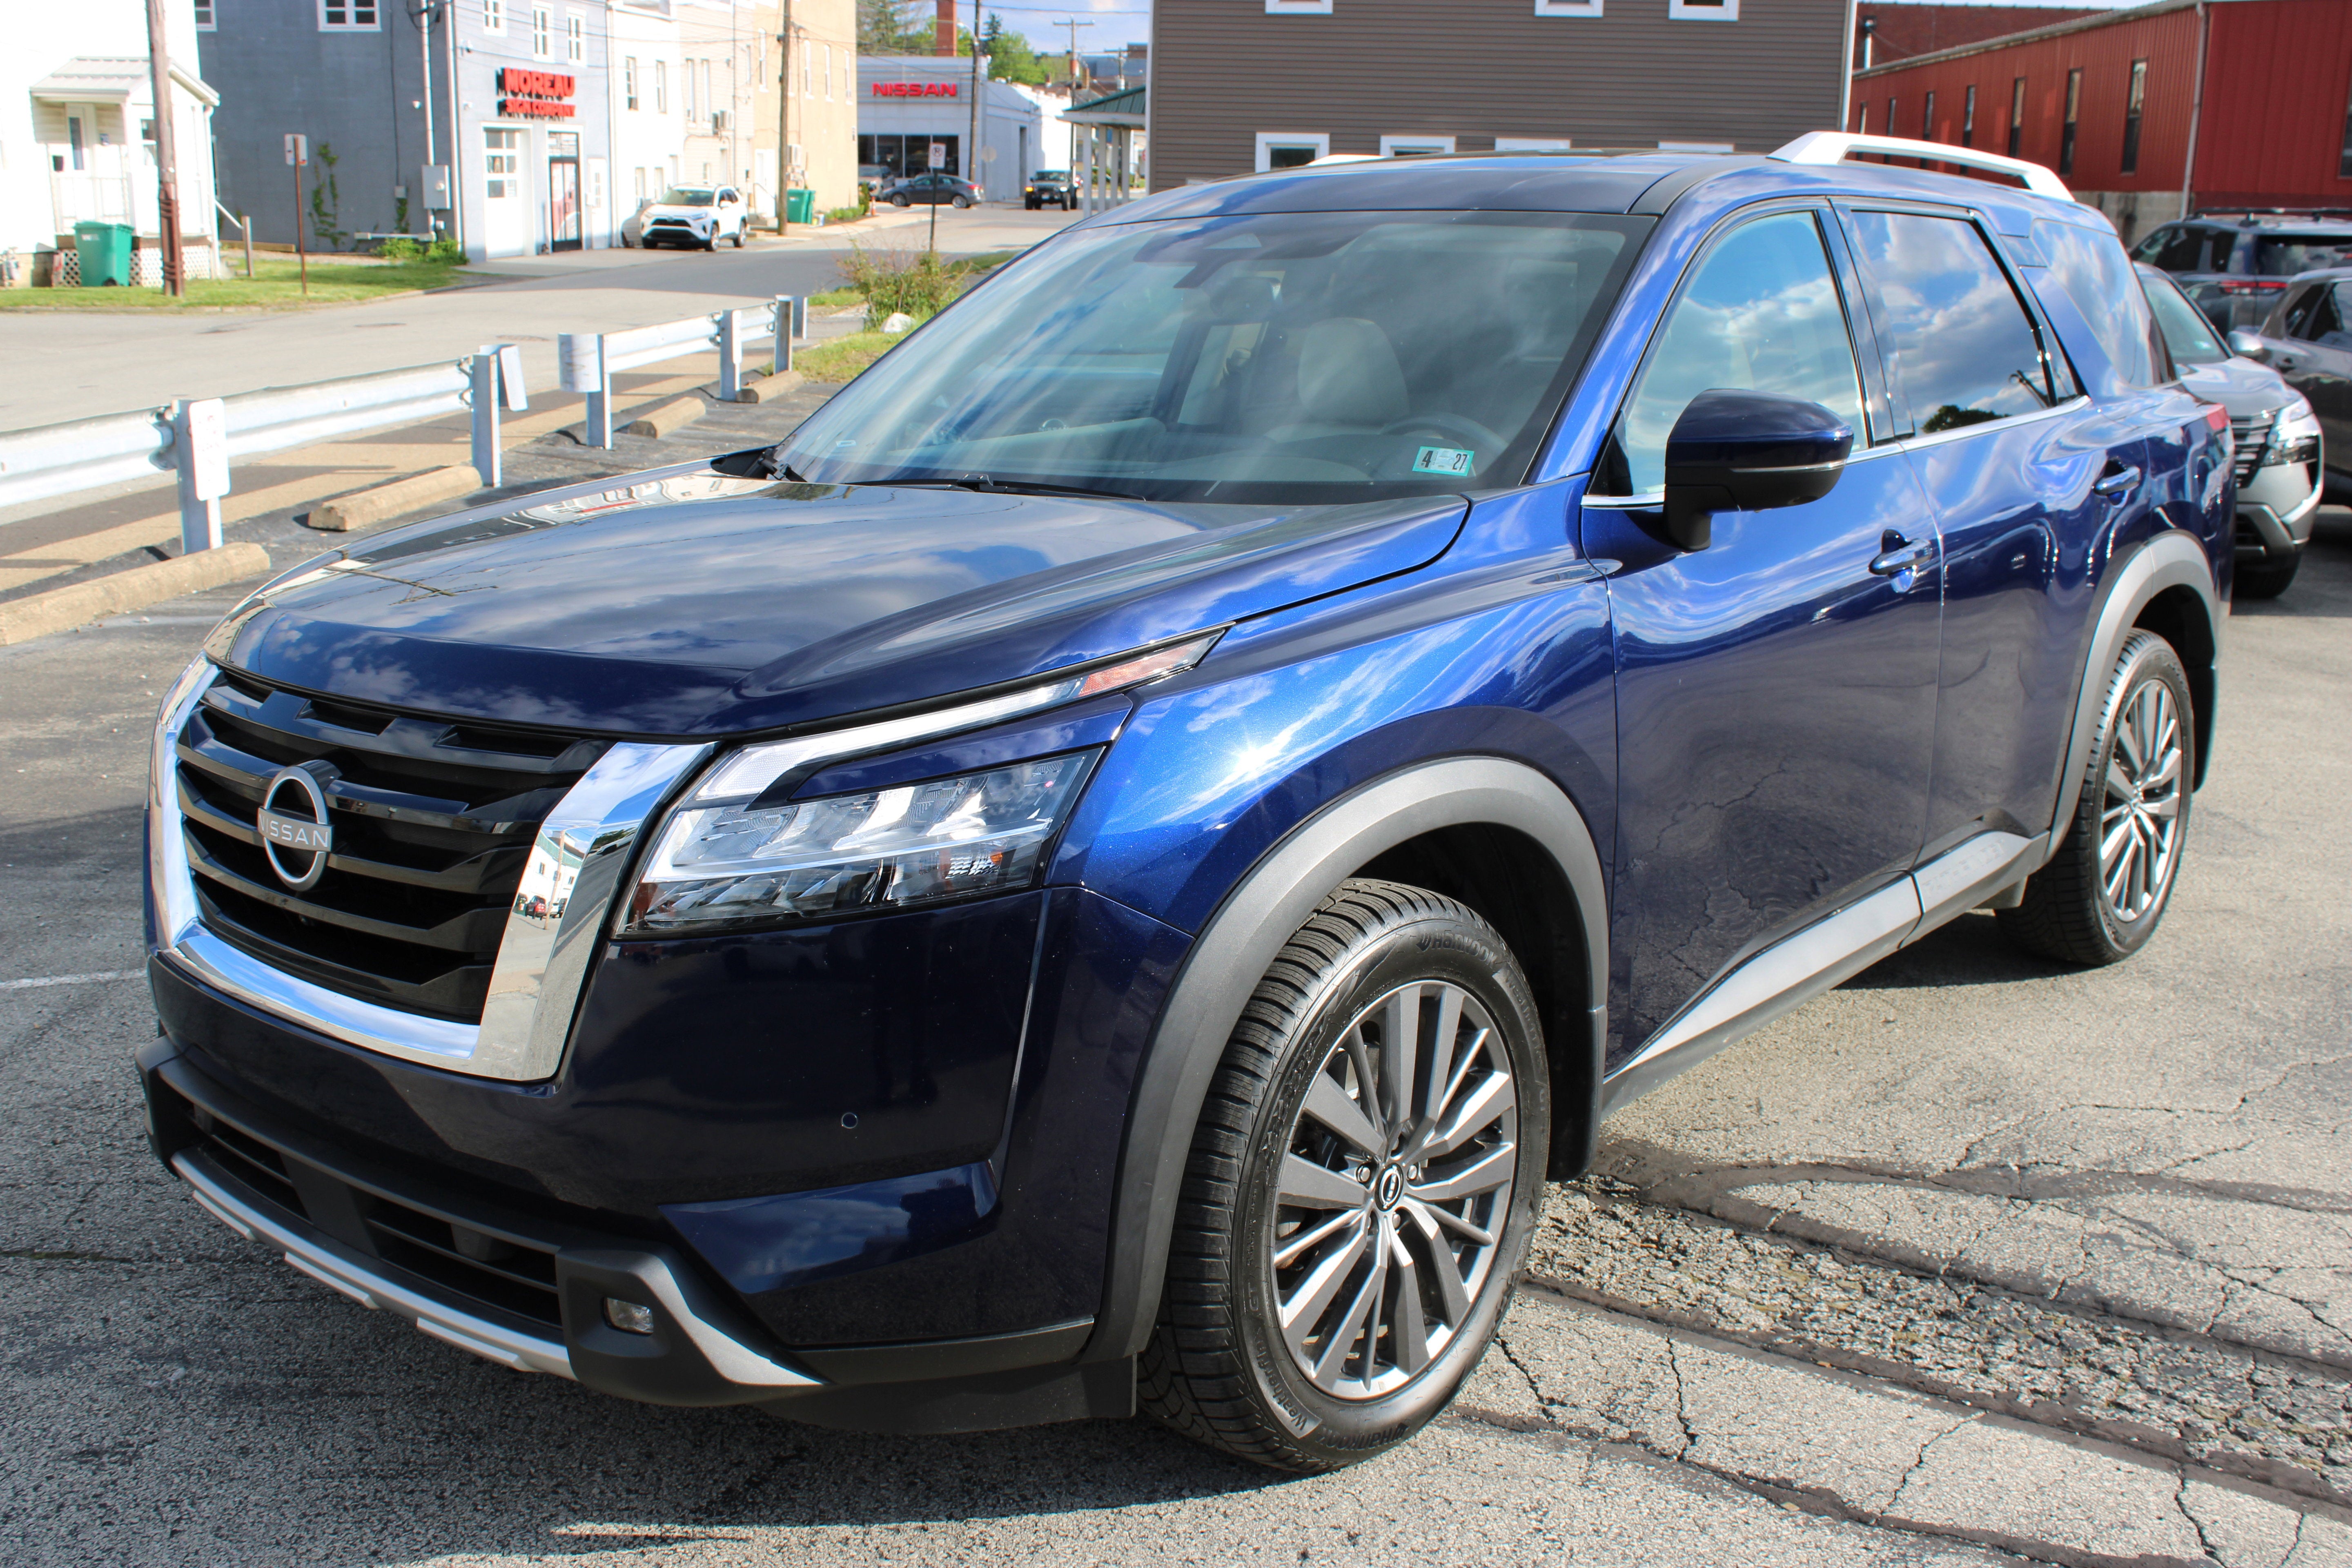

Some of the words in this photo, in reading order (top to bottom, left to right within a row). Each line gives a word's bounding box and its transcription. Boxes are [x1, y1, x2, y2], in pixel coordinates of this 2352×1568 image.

[504, 67, 575, 97] MOREAU
[871, 82, 957, 97] NISSAN
[1422, 450, 1434, 468] 4
[1452, 453, 1467, 472] 27
[259, 813, 328, 847] NISSAN
